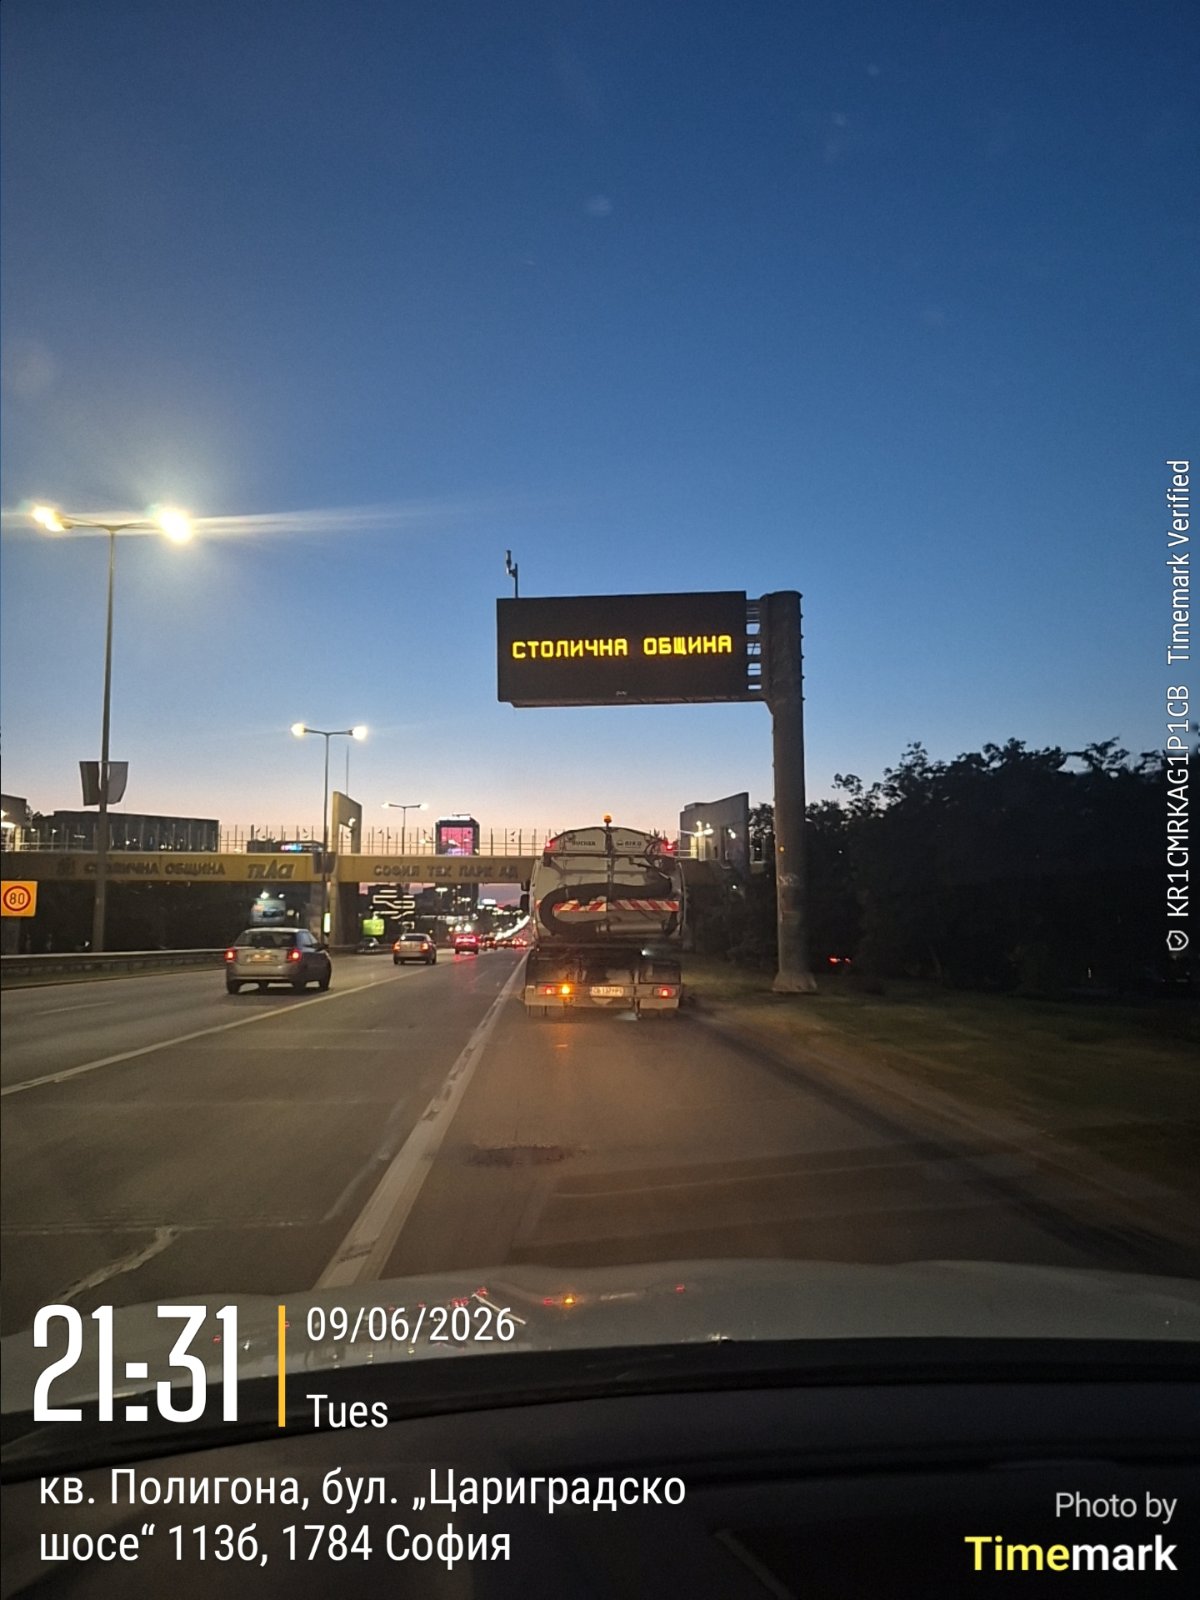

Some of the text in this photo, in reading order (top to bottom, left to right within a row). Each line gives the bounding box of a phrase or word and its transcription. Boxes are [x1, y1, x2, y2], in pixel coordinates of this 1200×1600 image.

[512, 635, 732, 659] СТОЛИЧНА ОБЩИНА
[84, 862, 226, 876] СОЛИЧНА ОБЩИНА
[374, 865, 420, 877] СОФИЯ
[428, 865, 453, 877] ТЕХ
[458, 865, 493, 877] ПАРК
[10, 892, 25, 905] 80
